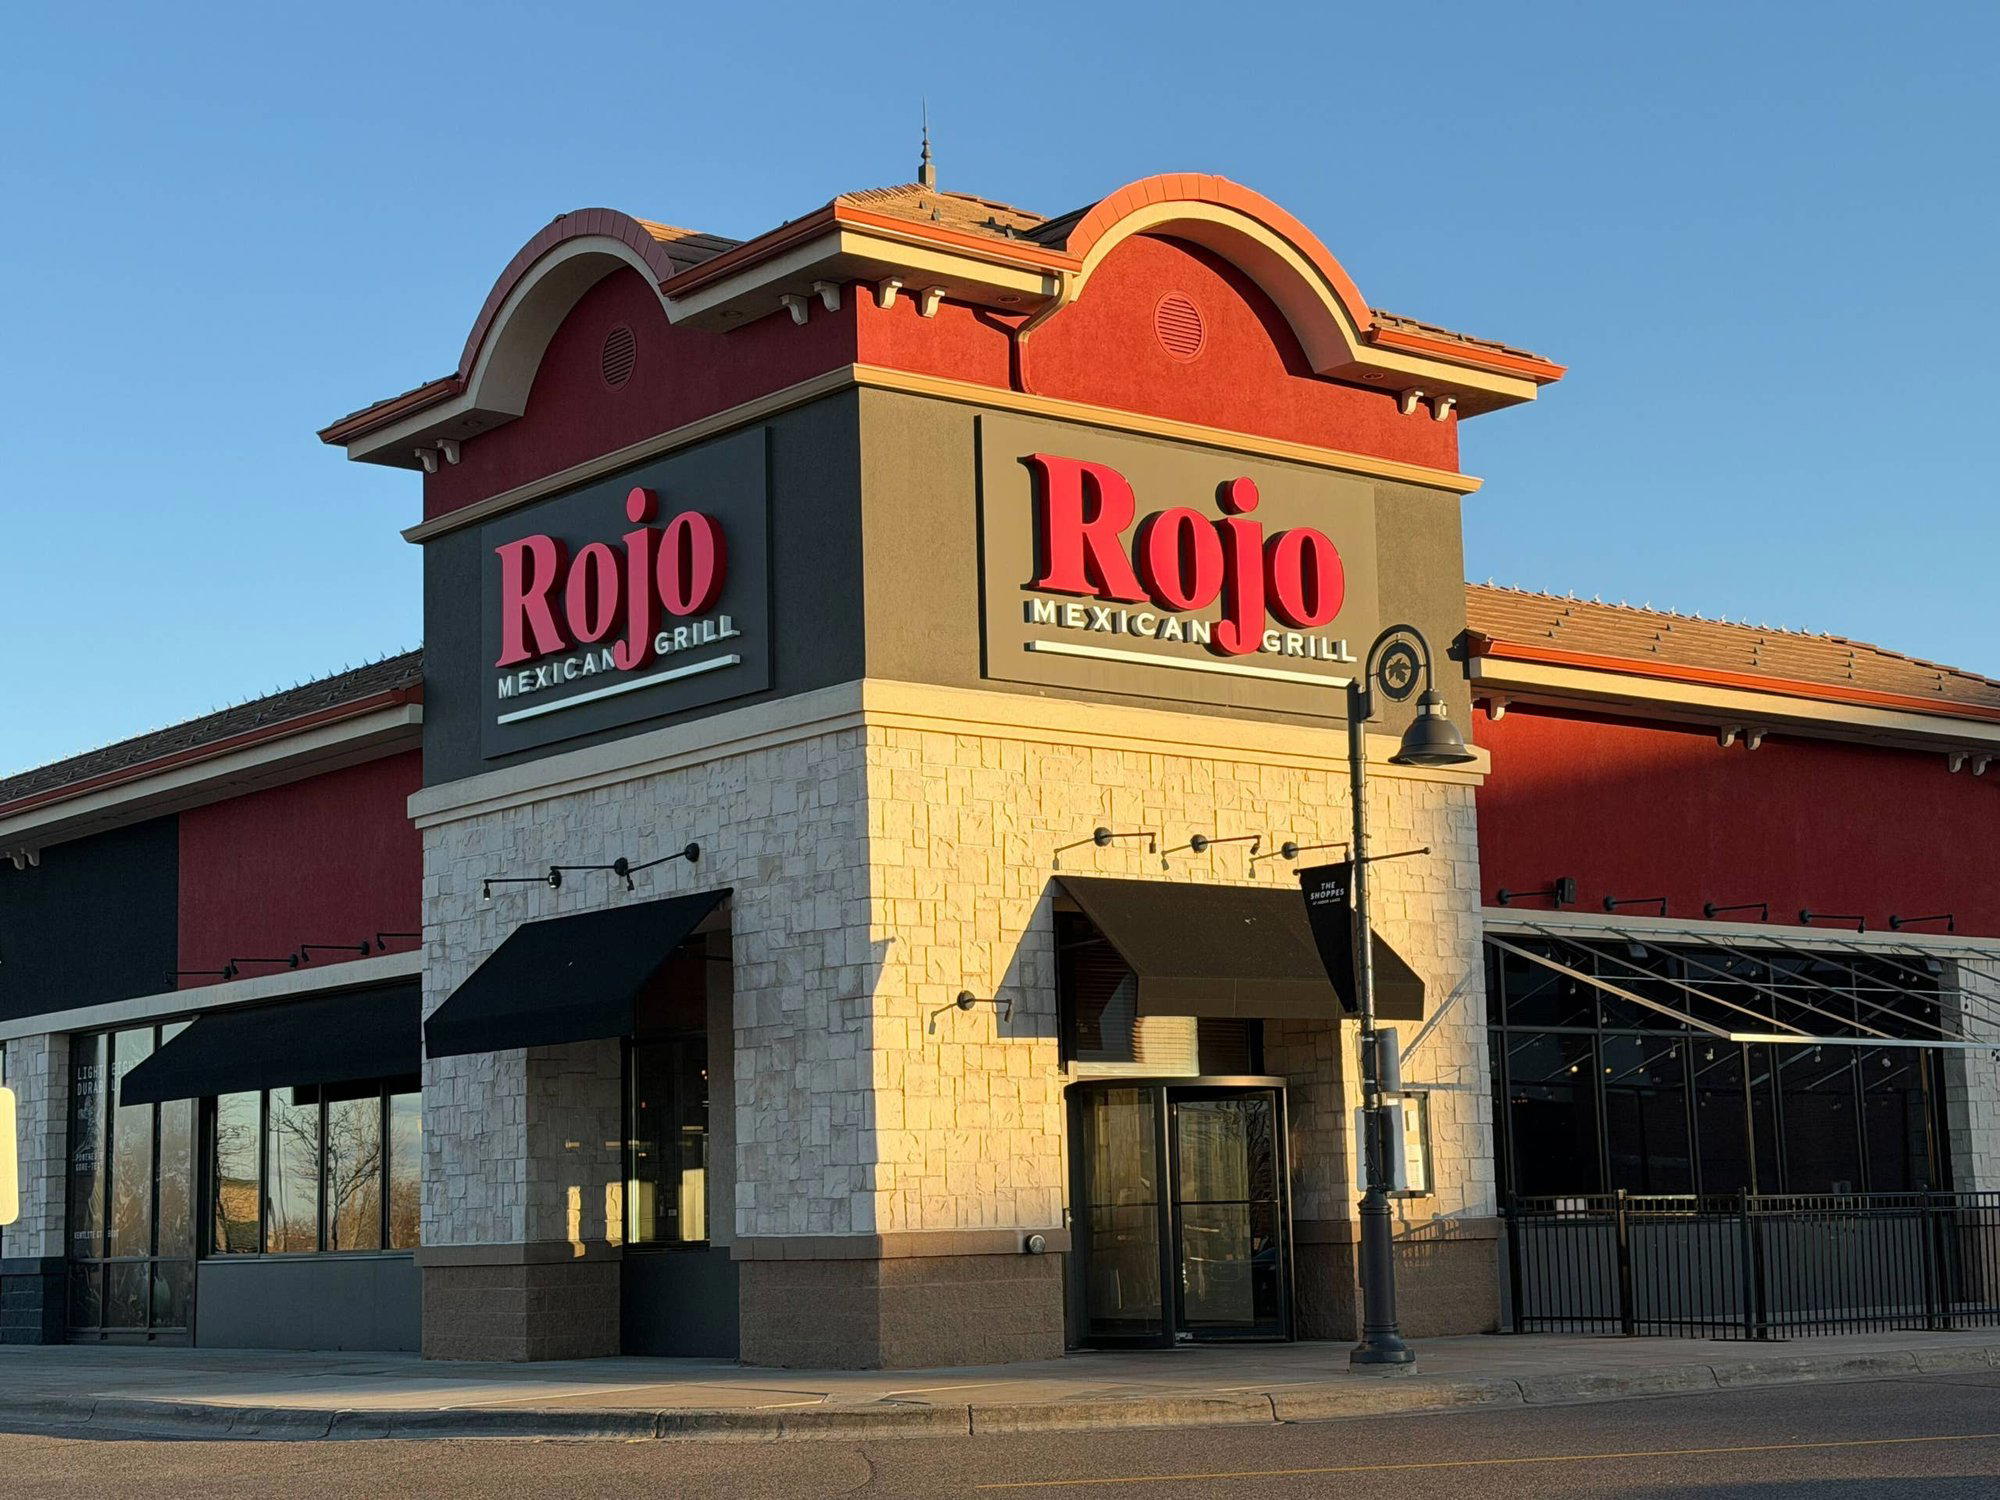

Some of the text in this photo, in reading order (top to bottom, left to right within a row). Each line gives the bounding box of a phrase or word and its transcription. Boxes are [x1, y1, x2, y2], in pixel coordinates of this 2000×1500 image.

[495, 486, 727, 671] Rojo
[1017, 453, 1345, 656] Rojo
[498, 614, 741, 700] MEXICAN GRILL
[1024, 598, 1358, 663] MEXICAN GRILL
[1310, 888, 1344, 900] SHOPPES
[1321, 881, 1336, 890] THE
